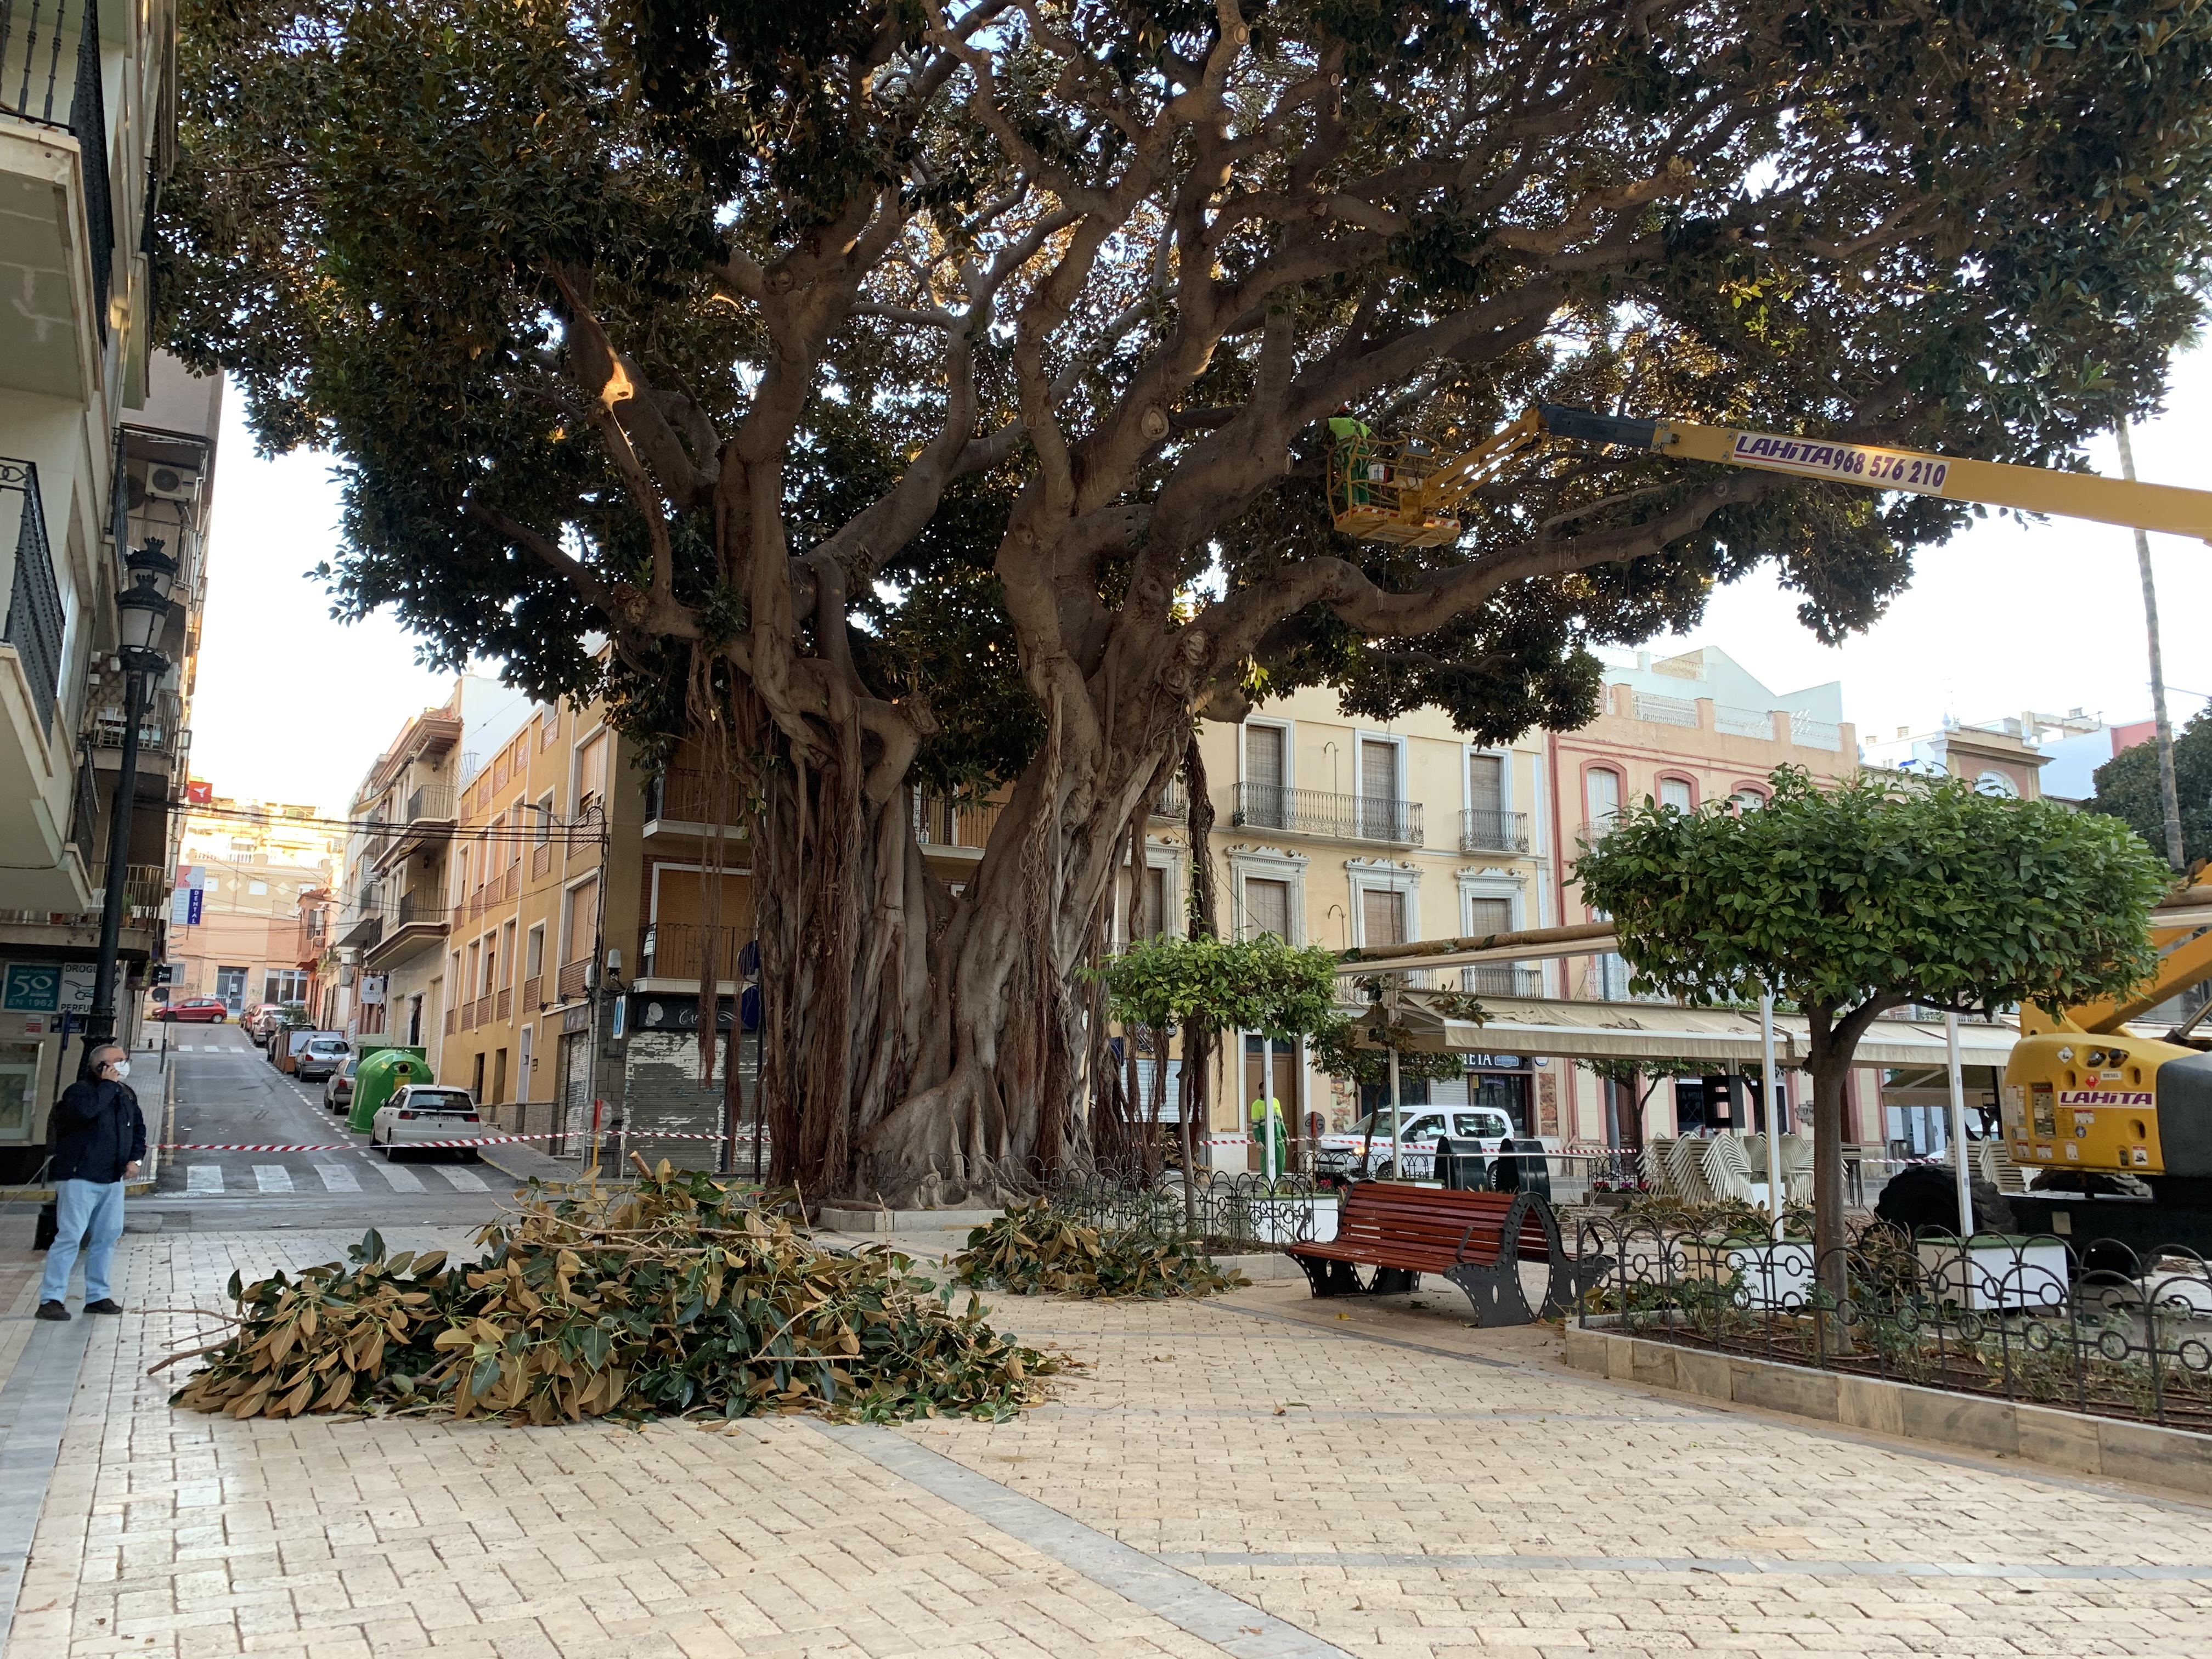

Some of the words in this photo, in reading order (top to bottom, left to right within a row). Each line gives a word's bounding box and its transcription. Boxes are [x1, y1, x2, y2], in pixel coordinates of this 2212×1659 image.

[1832, 449, 1866, 475] 968
[1869, 455, 1906, 481] 576
[1908, 461, 1946, 487] 210
[12, 975, 52, 997] 50
[29, 999, 53, 1007] 1962
